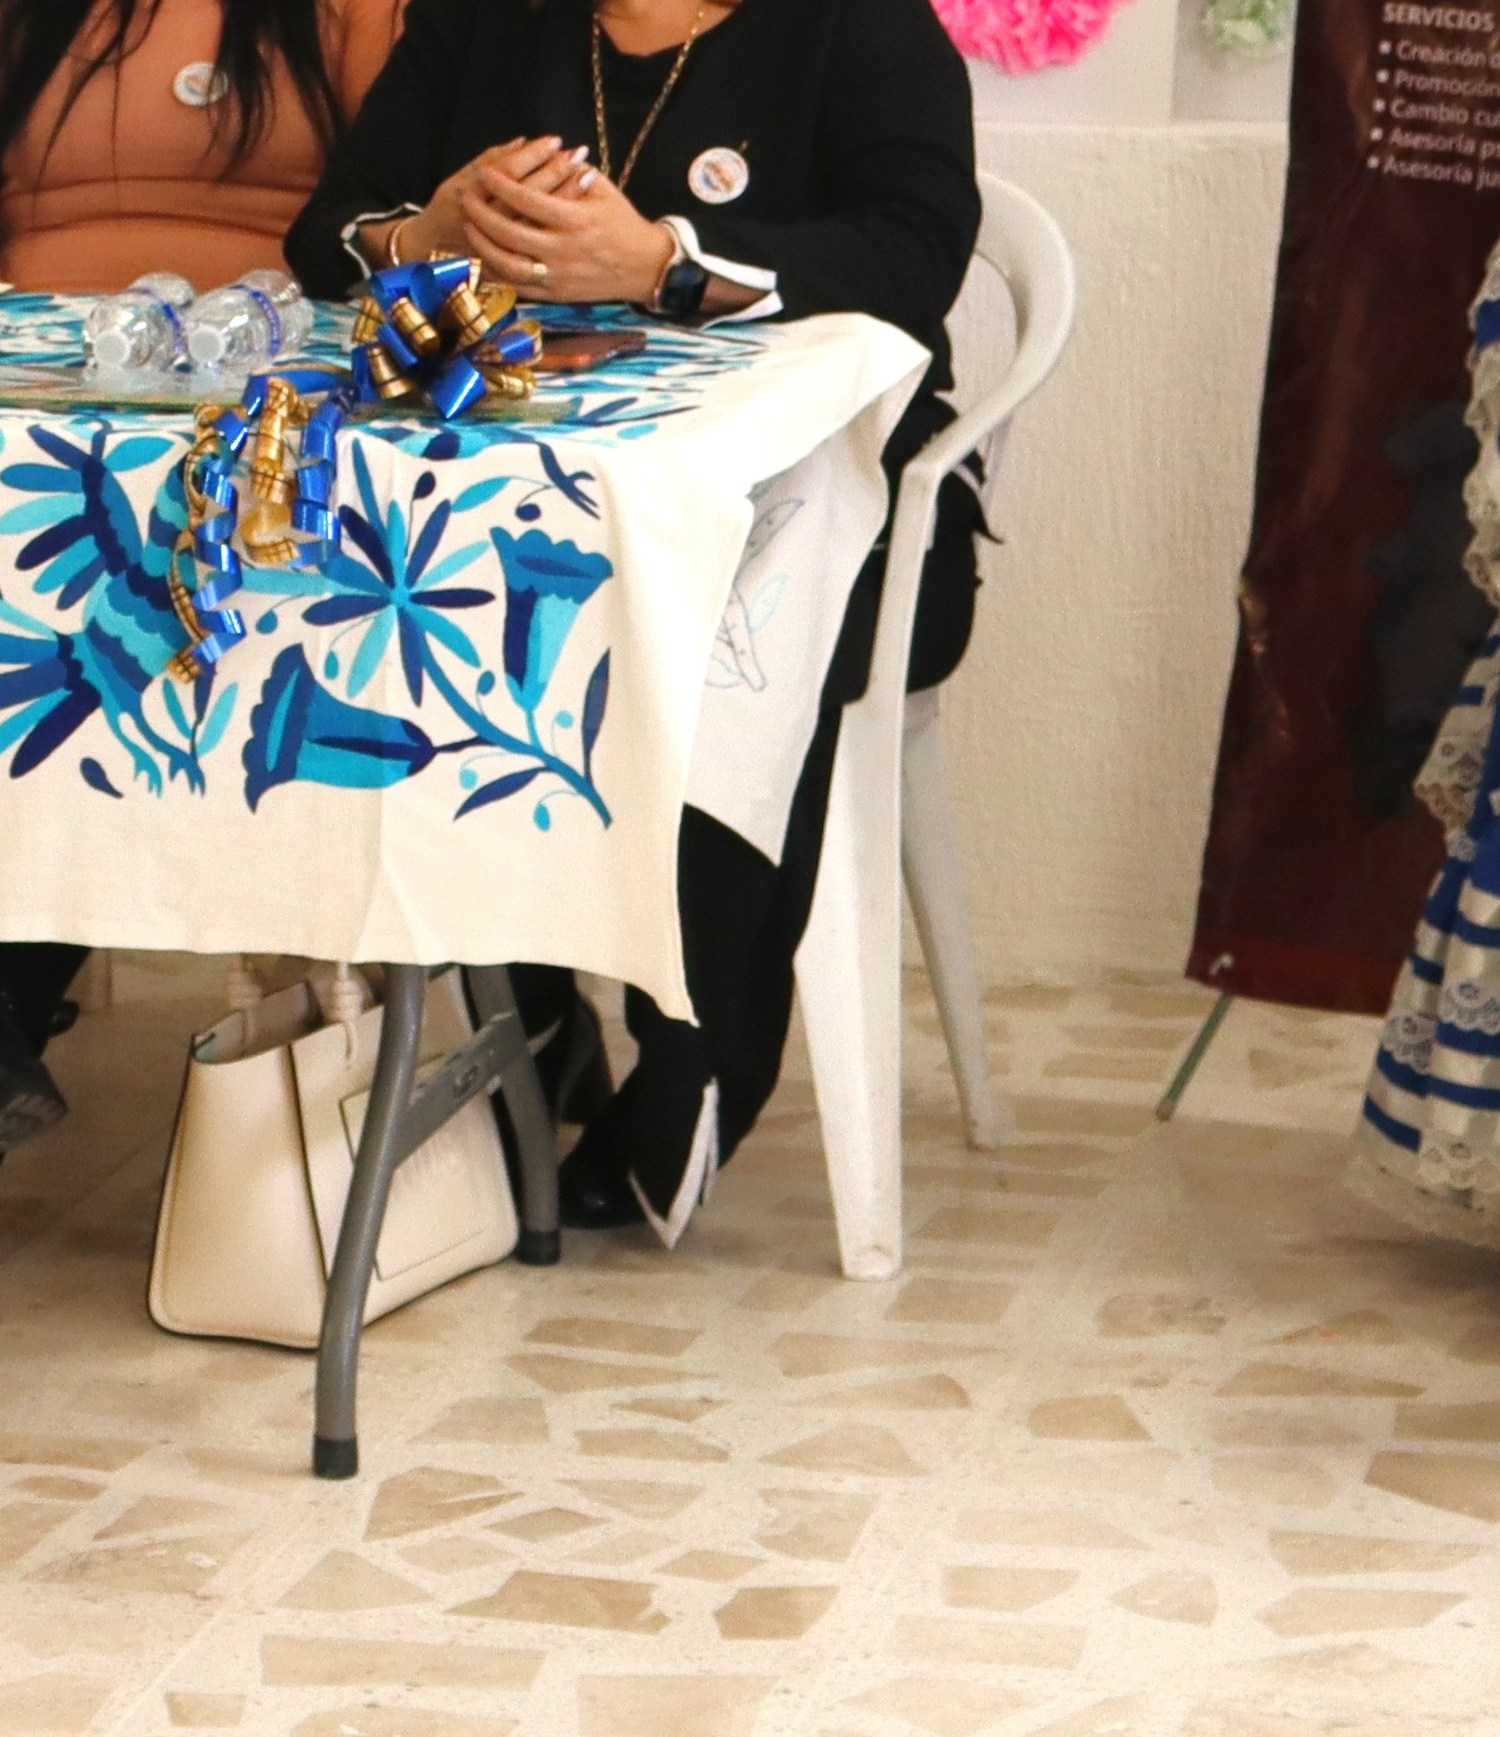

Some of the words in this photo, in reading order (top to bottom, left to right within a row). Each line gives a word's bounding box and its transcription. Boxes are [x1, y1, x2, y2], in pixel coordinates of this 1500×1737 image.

[1382, 1, 1496, 32] SERVICIOS
[1396, 40, 1486, 67] Creación
[1390, 99, 1470, 125] Cambio
[1388, 127, 1475, 155] Asesoría
[1382, 155, 1474, 185] Asesoría
